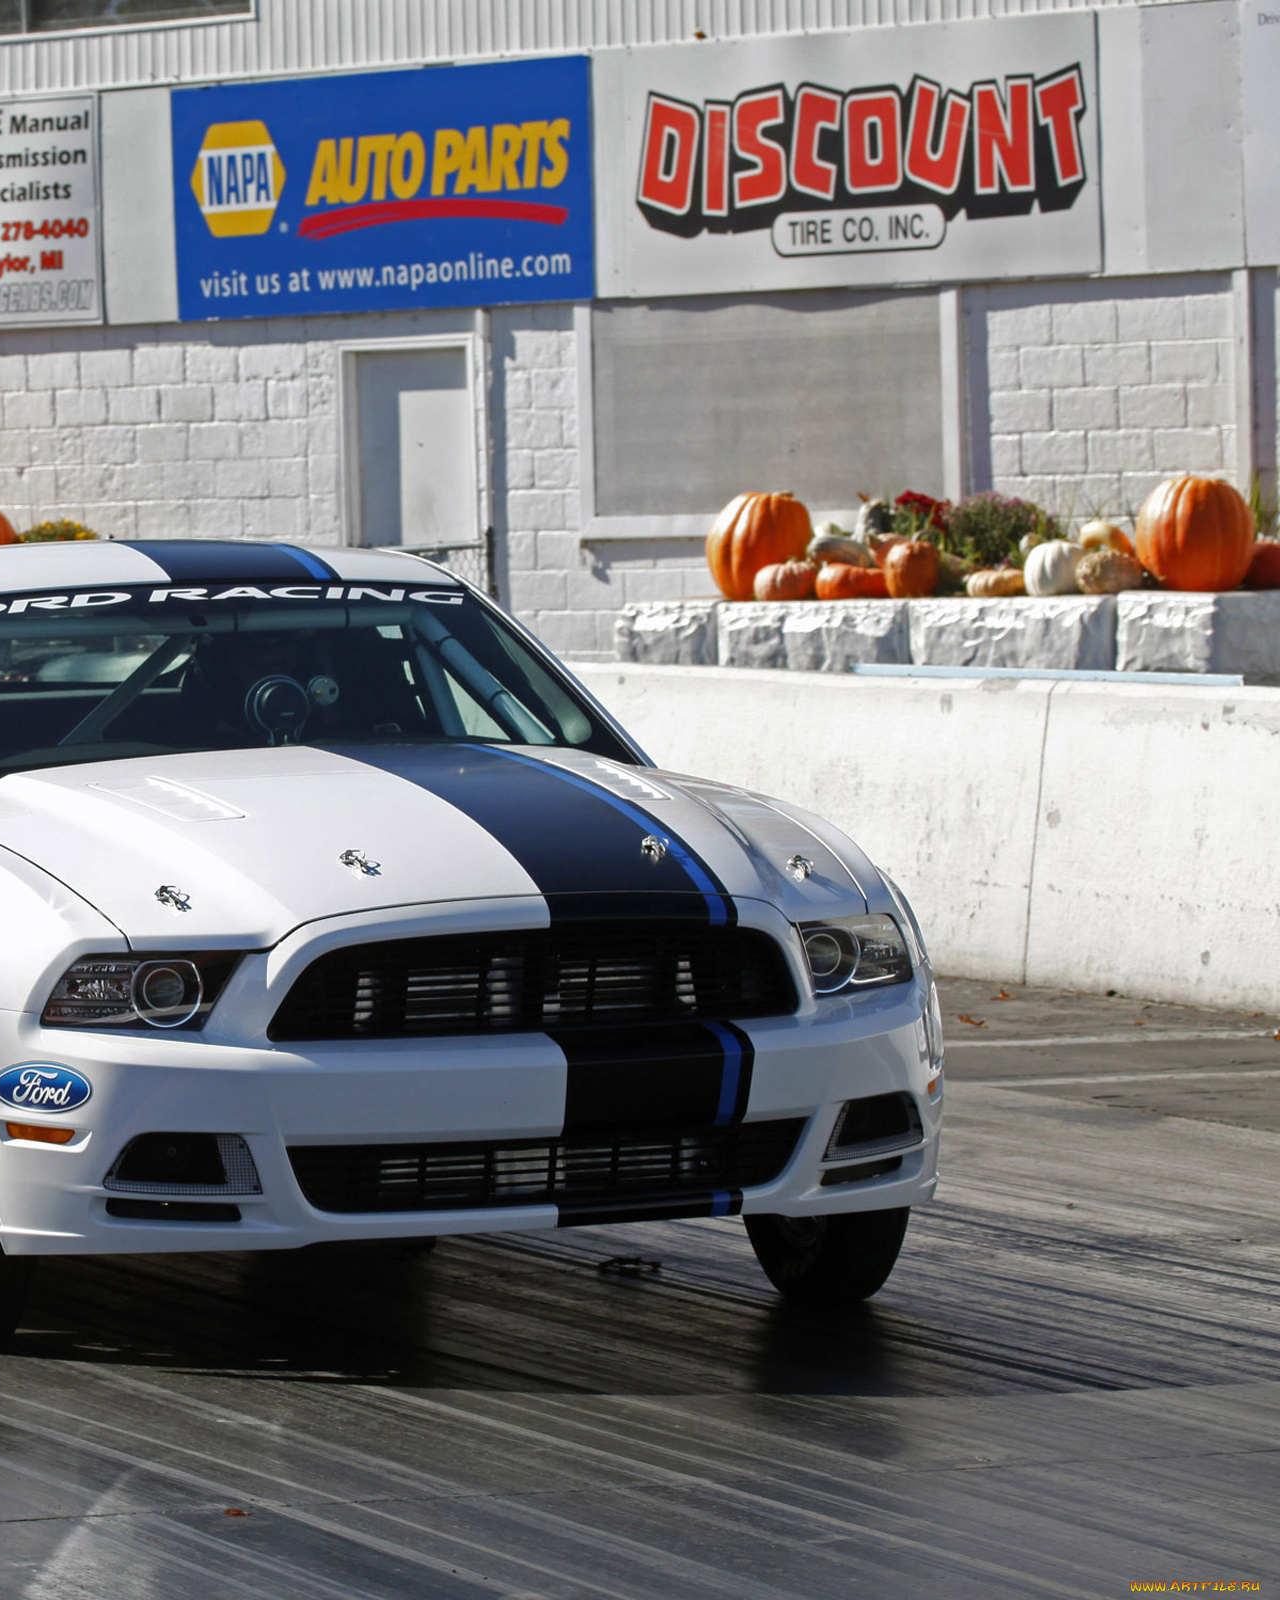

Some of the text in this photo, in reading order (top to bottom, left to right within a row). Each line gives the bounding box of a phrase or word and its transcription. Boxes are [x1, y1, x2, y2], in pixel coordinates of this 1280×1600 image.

[9, 110, 90, 135] Manual
[305, 118, 571, 206] AUTO PARTS
[637, 62, 1087, 230] DISCOUNT
[207, 151, 272, 207] NAPA
[1, 218, 89, 242] 278-4040
[788, 213, 931, 247] TIRE CO. INC.
[40, 250, 64, 271] MI
[200, 252, 572, 298] visit us at www.napaonline.com
[148, 586, 466, 606] RACING
[12, 1069, 73, 1107] Ford
